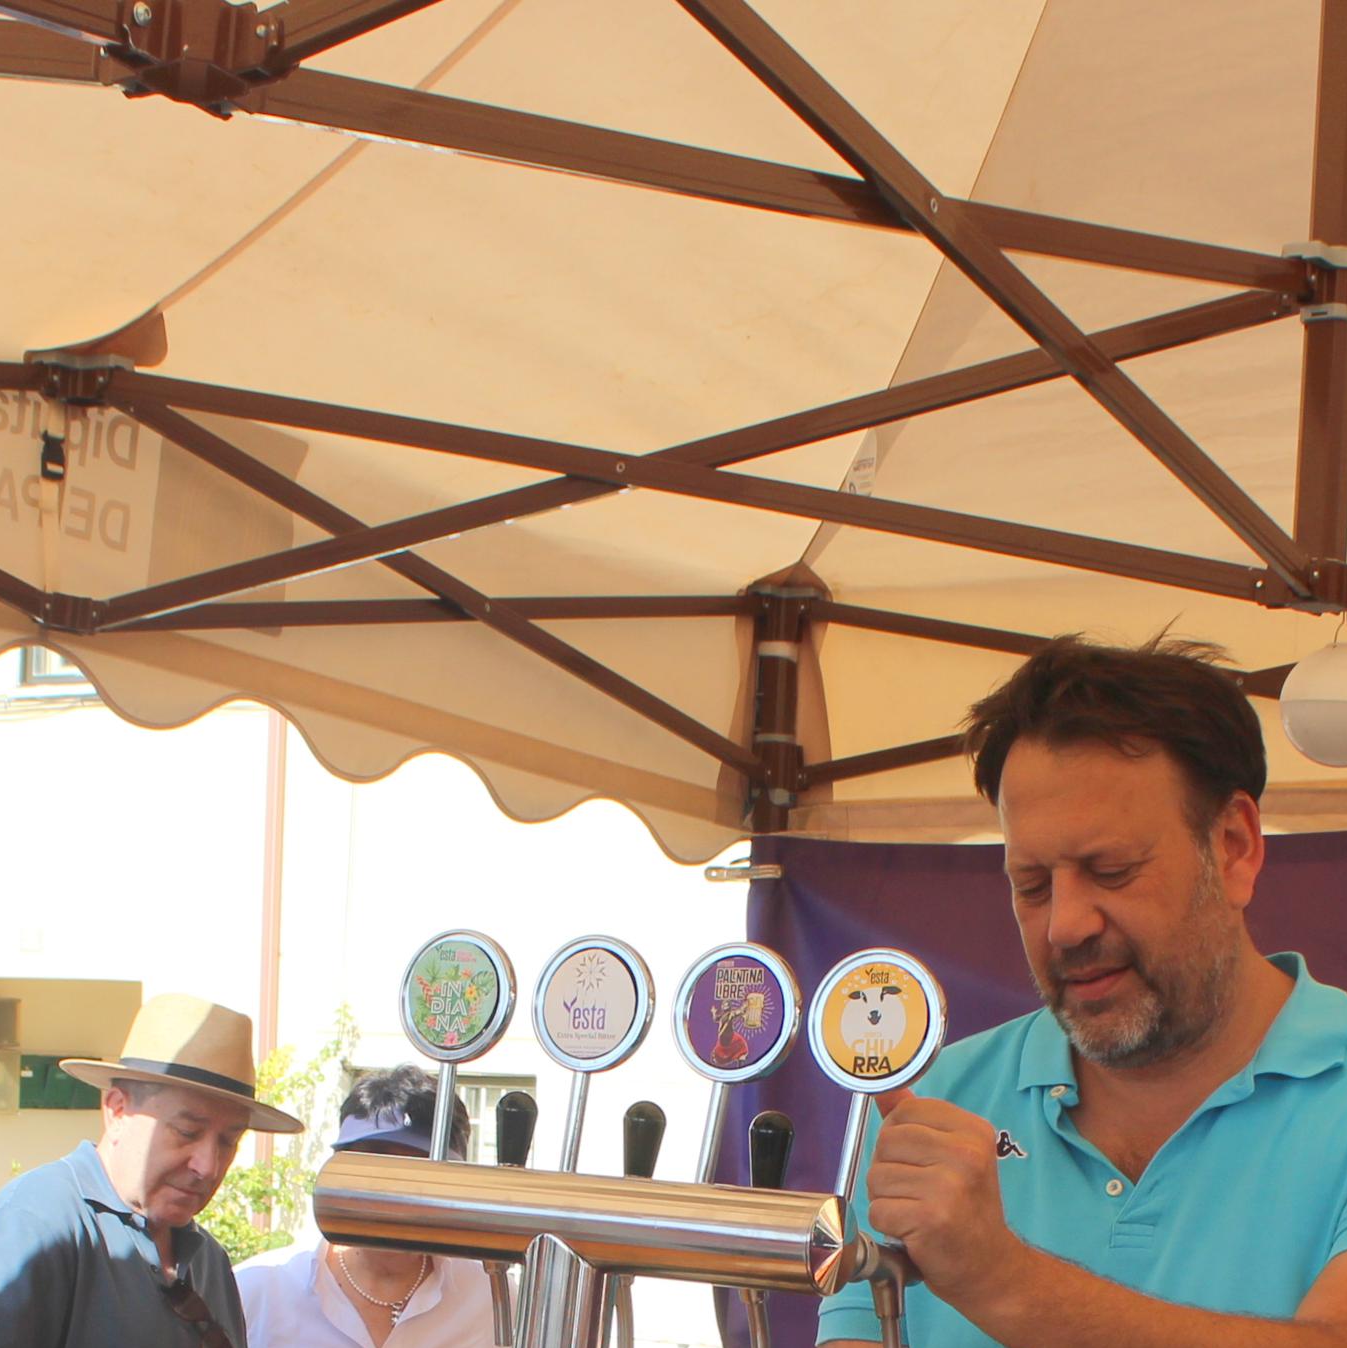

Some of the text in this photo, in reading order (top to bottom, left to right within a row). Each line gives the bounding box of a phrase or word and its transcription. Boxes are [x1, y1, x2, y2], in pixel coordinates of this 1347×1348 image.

[865, 967, 890, 985] Yesta
[562, 993, 607, 1031] Yesta
[852, 1056, 892, 1074] RRA
